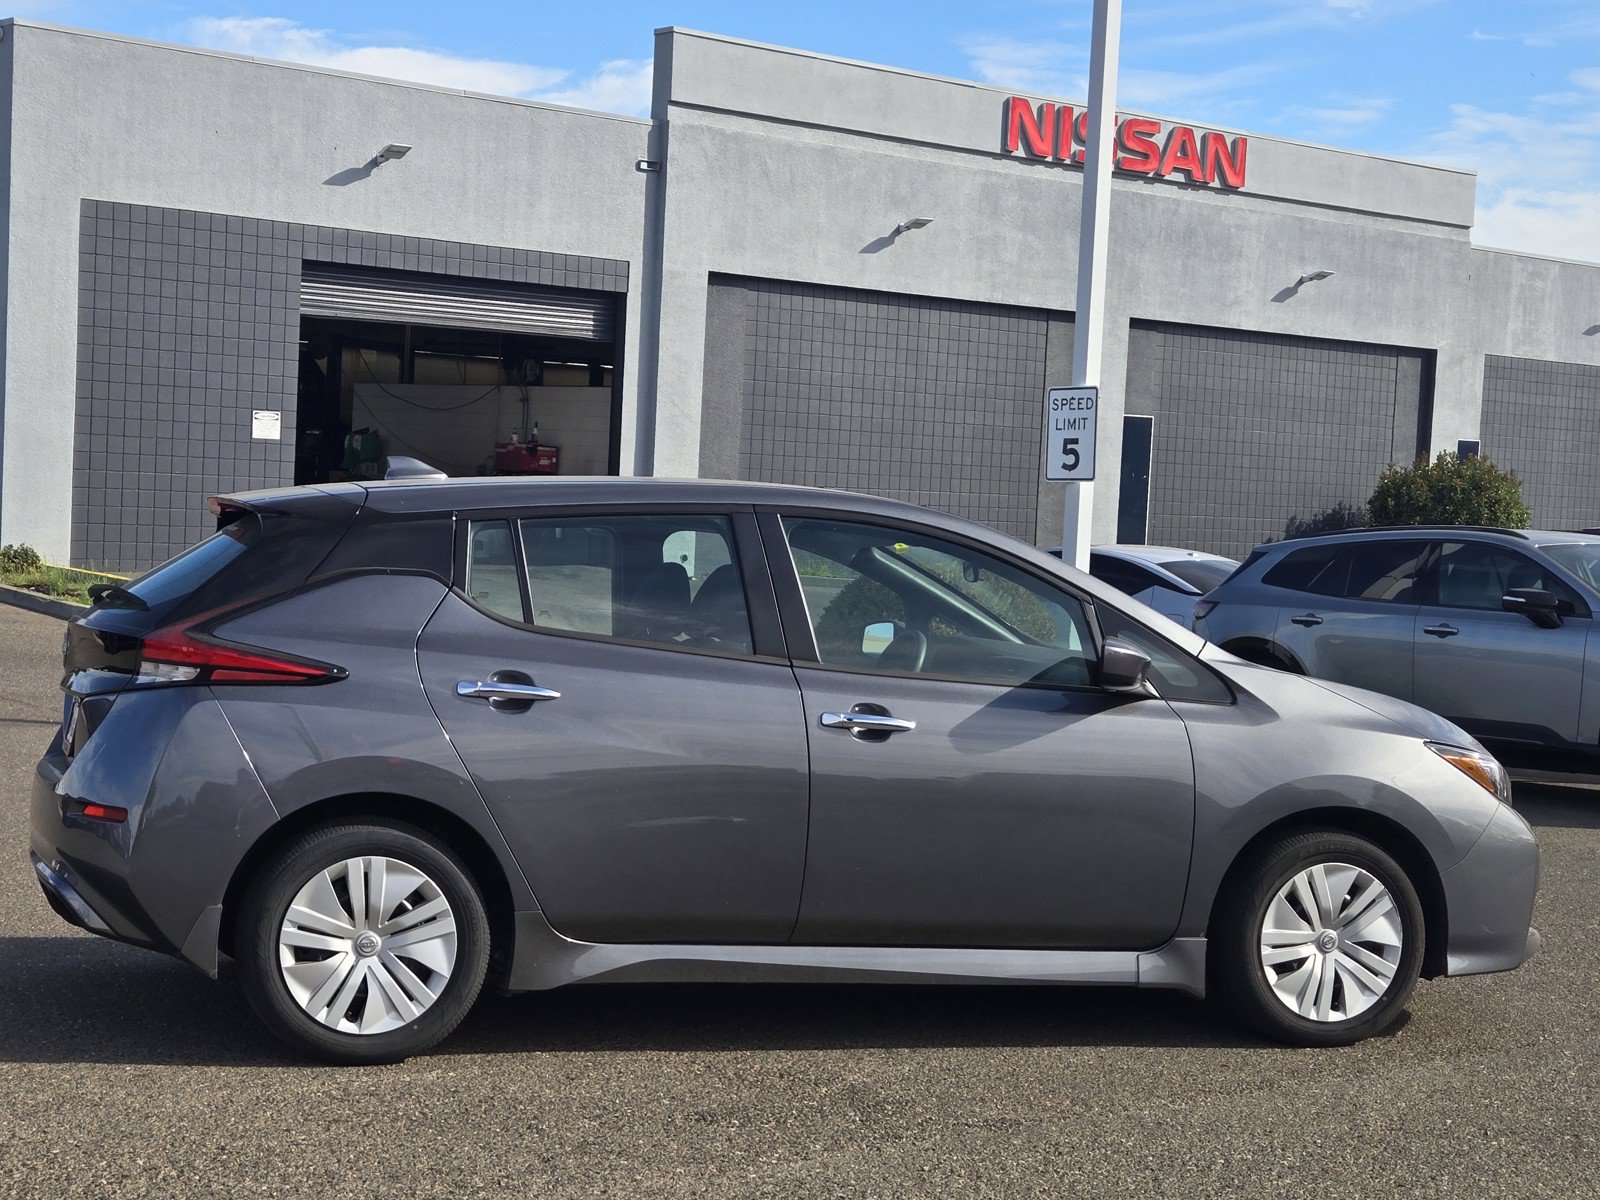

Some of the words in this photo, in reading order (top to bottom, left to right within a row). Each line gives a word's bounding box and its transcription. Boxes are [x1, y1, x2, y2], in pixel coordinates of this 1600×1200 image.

[1002, 96, 1248, 188] NISAN
[1051, 397, 1094, 411] SPEED
[1055, 418, 1088, 431] LIMIT
[1061, 438, 1081, 472] 5
